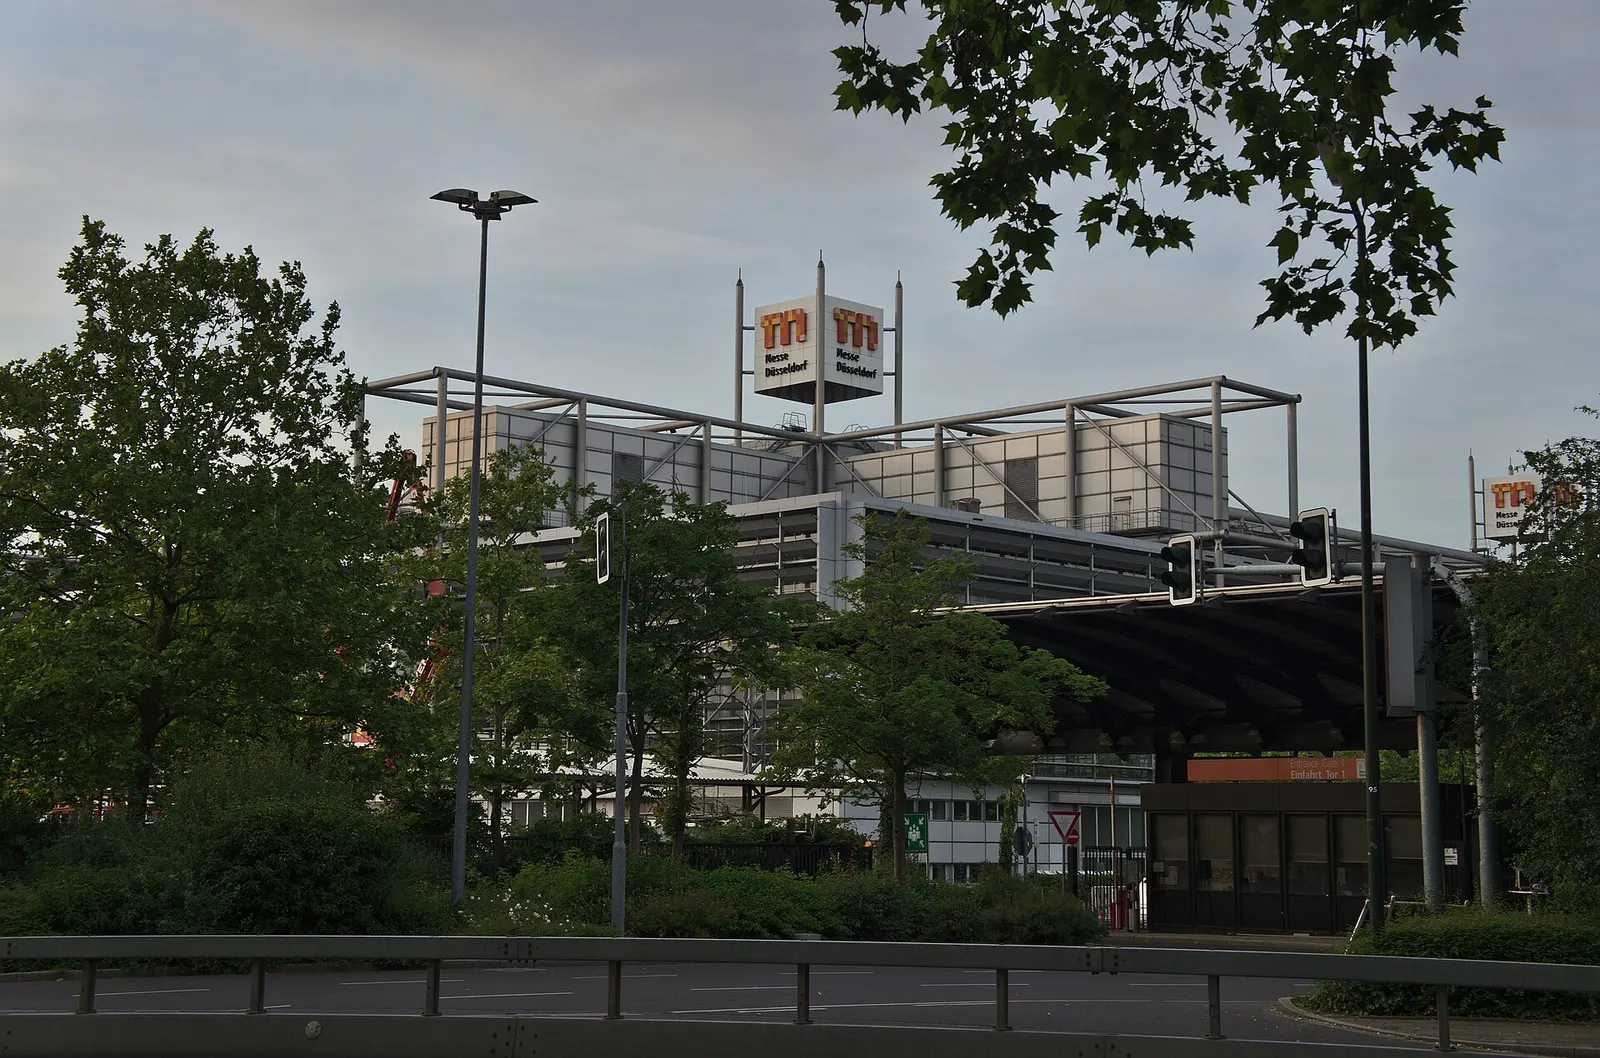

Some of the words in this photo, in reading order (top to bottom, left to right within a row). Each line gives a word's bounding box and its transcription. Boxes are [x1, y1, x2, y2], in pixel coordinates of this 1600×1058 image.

[765, 353, 789, 364] Messe
[836, 348, 860, 362] Messe
[765, 360, 808, 377] Düsseldorf
[836, 361, 877, 379] Düsseldorf
[1496, 511, 1518, 519] Messe
[1290, 759, 1319, 768] Entrance
[1321, 759, 1338, 768] Gate
[1290, 770, 1322, 779] Einfahrt
[1326, 770, 1338, 779] Tor
